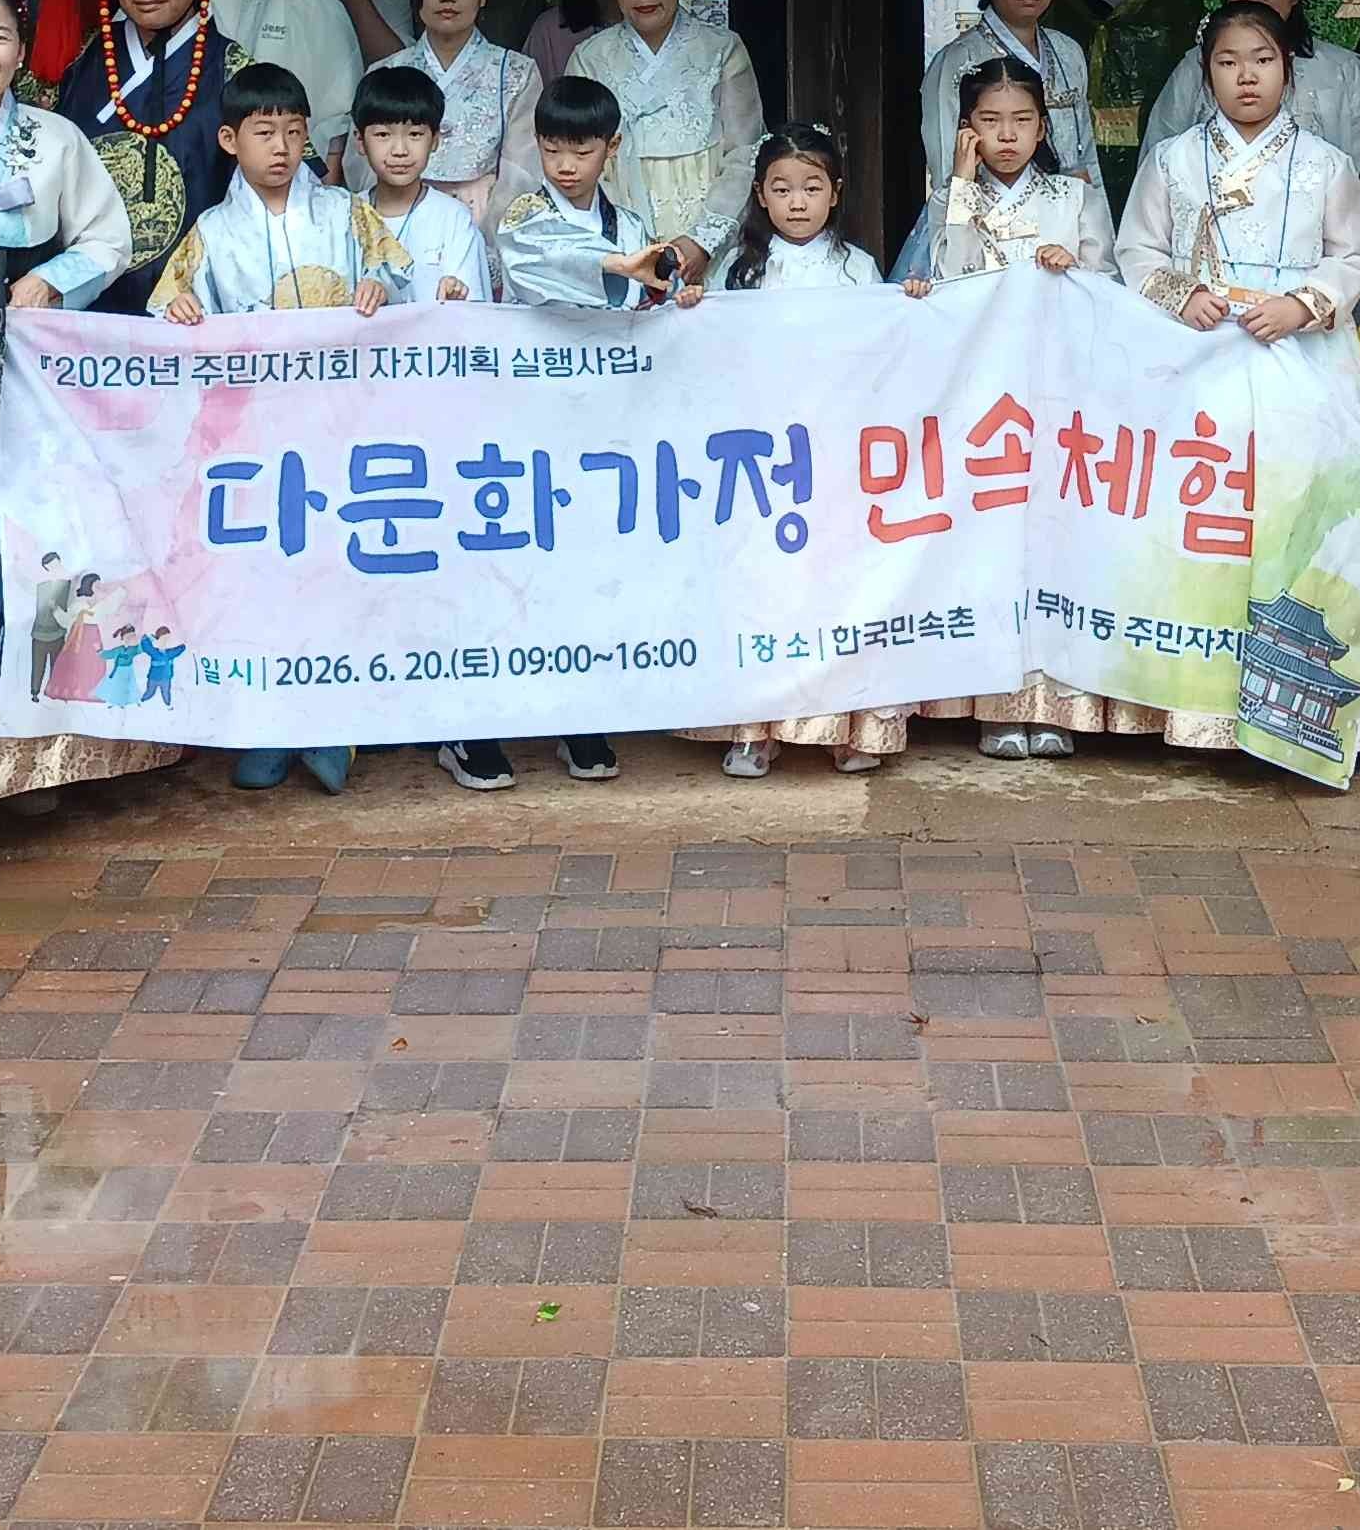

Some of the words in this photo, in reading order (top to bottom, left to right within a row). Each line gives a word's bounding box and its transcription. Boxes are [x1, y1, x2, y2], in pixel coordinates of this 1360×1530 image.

[190, 349, 359, 386] 주민자치회
[369, 345, 500, 381] 자치계획
[206, 422, 813, 575] 다문화가정
[859, 392, 1256, 559] 민속체험
[831, 605, 976, 657] 한국민속촌
[1035, 588, 1116, 642] 부평1동
[275, 654, 360, 686] 2026.
[368, 653, 396, 682] 6.
[507, 638, 698, 677] 09:00~16:00
